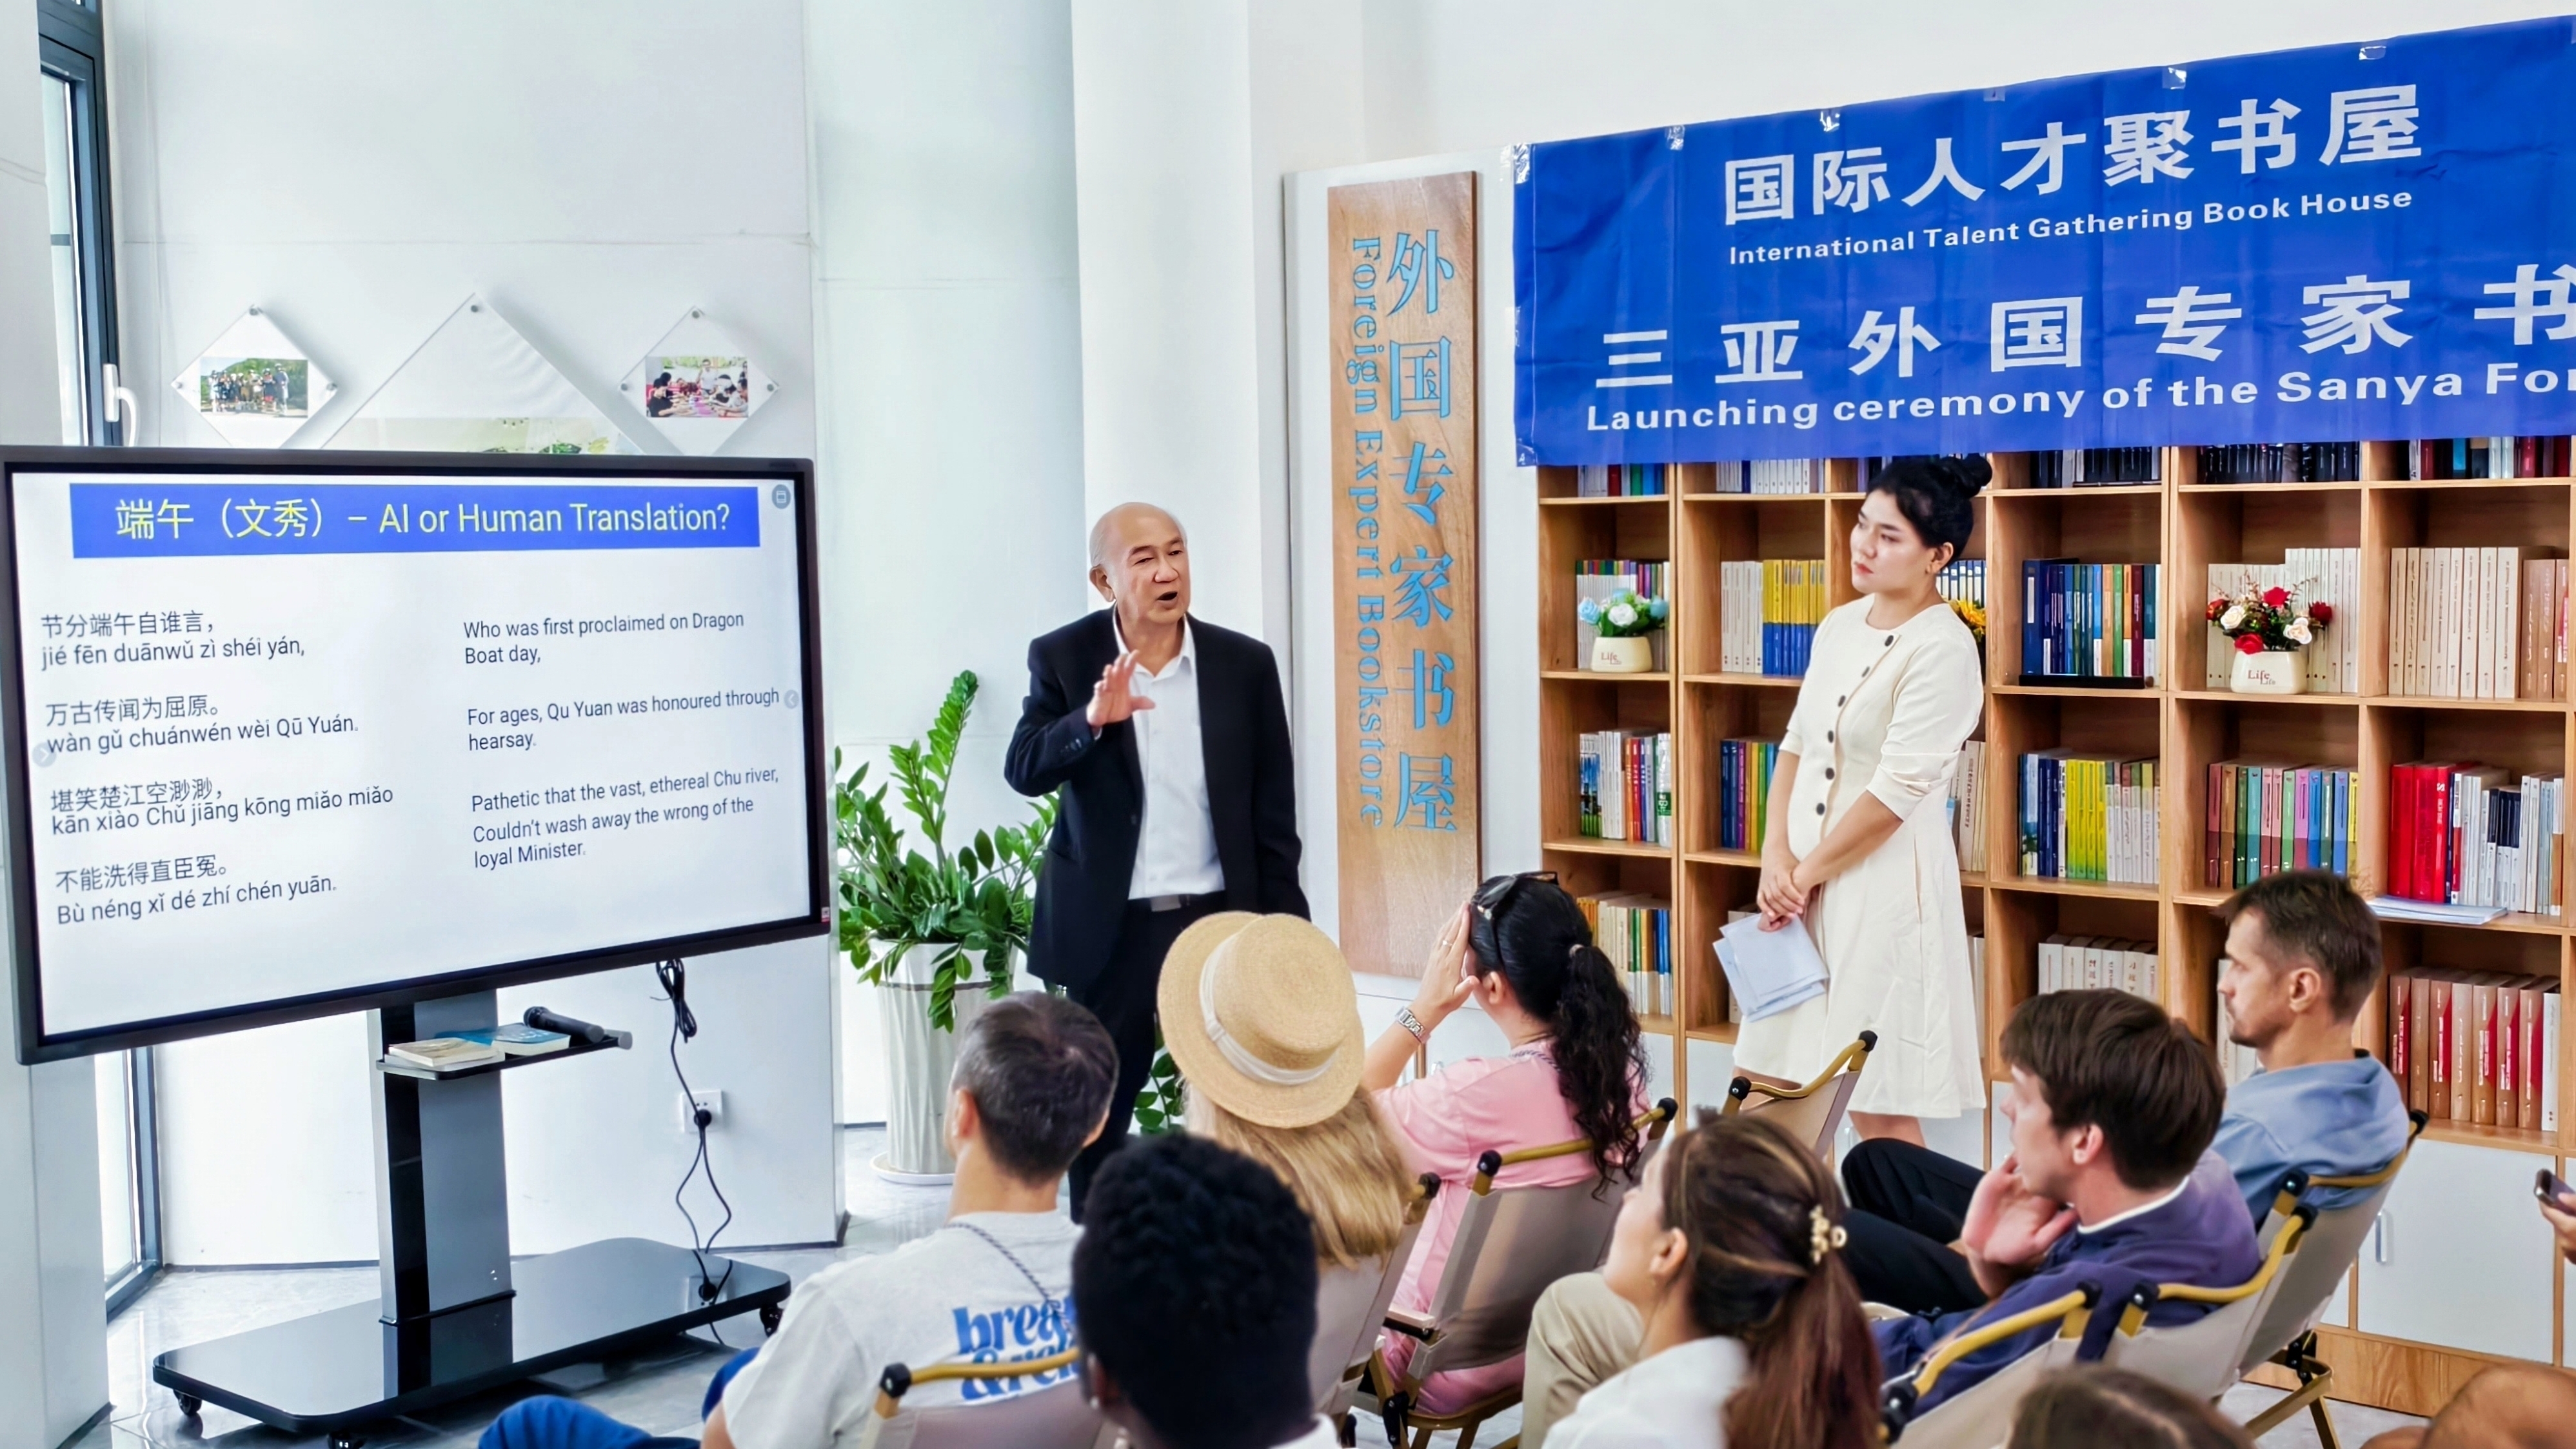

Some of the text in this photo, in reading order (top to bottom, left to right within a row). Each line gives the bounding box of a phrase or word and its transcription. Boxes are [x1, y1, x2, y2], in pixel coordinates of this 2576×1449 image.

[1725, 84, 2421, 225] 国际人才聚书屋
[1730, 192, 2412, 265] International Talent Gathering Book House
[1596, 264, 2576, 388] 三亚外国专家书
[1587, 399, 1818, 430] Launching
[1833, 390, 2085, 421] ceremony
[2103, 378, 2152, 409] of
[2167, 376, 2258, 406] the
[2277, 371, 2462, 405] Sanya
[114, 497, 322, 540] 端午（文秀）
[379, 503, 409, 534] AI
[419, 510, 450, 533] or
[458, 503, 562, 532] Human
[569, 501, 729, 532] Translation?
[1347, 237, 1389, 826] Foreign Expert Bookstore
[1387, 229, 1456, 832] 外国专家书屋
[463, 612, 744, 639] Who was first proclaimed on Dragon
[41, 637, 305, 672] jié fēn duānwǔ zì shéi yán,
[465, 644, 541, 666] Boat day,
[2248, 670, 2270, 679] Life
[46, 694, 218, 727] 万古传闻为屈原。
[468, 687, 780, 727] For ages, Qu Yuan was honoured through
[46, 732, 91, 754] wàn
[98, 729, 123, 755] gǔ
[129, 722, 232, 748] chuánwén
[237, 719, 270, 739] wèi
[276, 717, 302, 739] Qū
[469, 732, 537, 751] hearsay.
[52, 785, 393, 835] kān xiào Chǔ jiāng kōng miǎo miǎo
[471, 769, 778, 812] Pathetic that the vast, ethereal Chu river,
[545, 814, 587, 834] wash
[591, 813, 631, 830] away
[635, 807, 659, 824] the
[663, 804, 709, 821] wrong
[713, 797, 728, 815] of
[730, 796, 753, 814] the
[55, 854, 226, 894] 不能洗得直臣冤。
[475, 841, 586, 871] loyal Minister.
[57, 903, 84, 924] Bù
[92, 898, 142, 921] néng
[148, 892, 165, 914] xǐ
[171, 889, 196, 910] dé
[202, 884, 231, 907] zhí
[236, 880, 282, 903] chén
